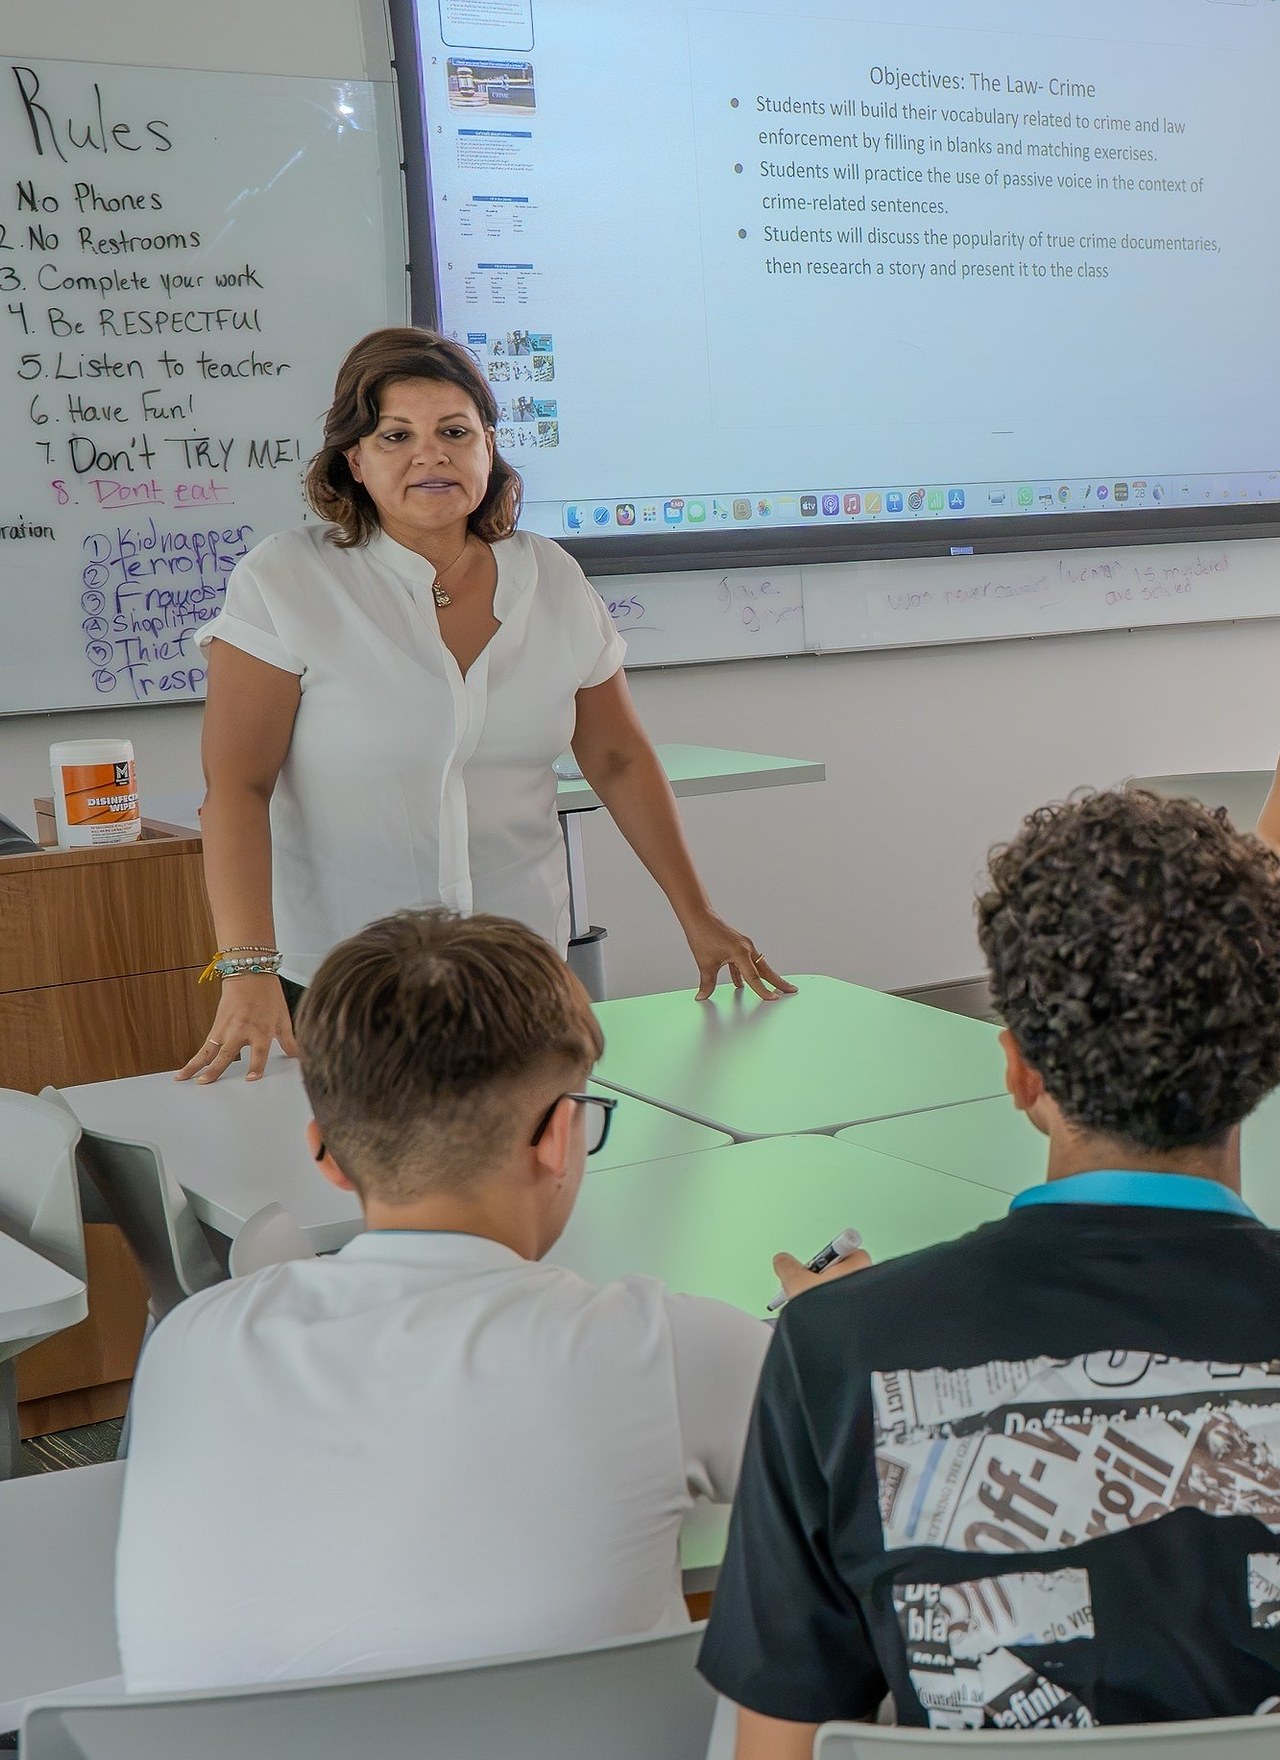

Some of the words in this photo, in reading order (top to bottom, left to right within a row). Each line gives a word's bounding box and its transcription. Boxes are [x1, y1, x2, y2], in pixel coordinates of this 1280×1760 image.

[869, 65, 966, 92] Objectives:
[969, 71, 1001, 93] The
[1005, 74, 1044, 96] Law-
[1048, 77, 1097, 99] Crime
[12, 66, 172, 163] Rules
[755, 95, 826, 116] Students
[829, 100, 856, 117] will
[860, 100, 899, 120] build
[902, 103, 938, 122] their
[940, 105, 1019, 130] vocabulary
[1022, 109, 1072, 129] related
[1074, 114, 1090, 130] to
[1092, 113, 1131, 133] crime
[1134, 115, 1160, 134] and
[1162, 117, 1186, 135] law
[758, 127, 859, 150] enforcement
[862, 132, 882, 153] by
[884, 132, 925, 156] filling
[929, 136, 944, 153] in
[946, 136, 993, 155] blanks
[996, 138, 1023, 157] and
[1026, 140, 1091, 162] matching
[1093, 144, 1158, 163] exercises.
[759, 160, 830, 181] Students
[832, 162, 860, 182] will
[864, 165, 924, 187] practice
[926, 166, 952, 184] the
[955, 171, 981, 186] use
[983, 169, 1000, 187] of
[1002, 171, 1054, 191] passive
[1056, 173, 1093, 189] voice
[1095, 173, 1109, 190] in
[1112, 174, 1135, 192] the
[1137, 176, 1187, 193] context
[1189, 176, 1204, 194] of
[16, 180, 59, 213] No
[74, 182, 163, 213] Phones
[761, 193, 867, 213] crime-related
[870, 197, 949, 216] sentences.
[28, 224, 60, 252] No
[78, 226, 201, 256] Restrooms
[763, 225, 833, 246] Students
[836, 227, 864, 246] will
[867, 227, 920, 247] discuss
[923, 228, 949, 247] the
[951, 229, 1026, 252] popularity
[1028, 230, 1044, 248] of
[1045, 232, 1076, 249] true
[1078, 232, 1118, 250] crime
[1120, 234, 1222, 254] documentaries,
[37, 263, 150, 299] Complete
[160, 273, 206, 300] your
[214, 264, 264, 291] work
[764, 257, 802, 276] then
[805, 258, 872, 277] research
[875, 263, 885, 277] a
[888, 260, 927, 281] story
[929, 260, 958, 278] and
[960, 262, 1016, 281] present
[1018, 260, 1029, 278] it
[1031, 261, 1047, 279] to
[1049, 261, 1074, 279] the
[1076, 262, 1109, 280] class
[7, 301, 36, 336] 4.
[48, 308, 85, 338] Be
[17, 353, 50, 380] 5.
[55, 352, 144, 381] Listen
[157, 351, 185, 378] to
[197, 350, 292, 380] teacher
[29, 394, 60, 425] 6.
[68, 393, 129, 423] Have
[35, 441, 55, 464] 7.
[69, 433, 157, 474] Don't
[164, 434, 235, 472] TRY
[52, 479, 79, 505] 8.
[174, 478, 230, 502] eat
[1134, 488, 1146, 499] 28
[117, 516, 254, 556] Kidnapper
[114, 627, 199, 662] Thief
[117, 663, 208, 700] Tresp
